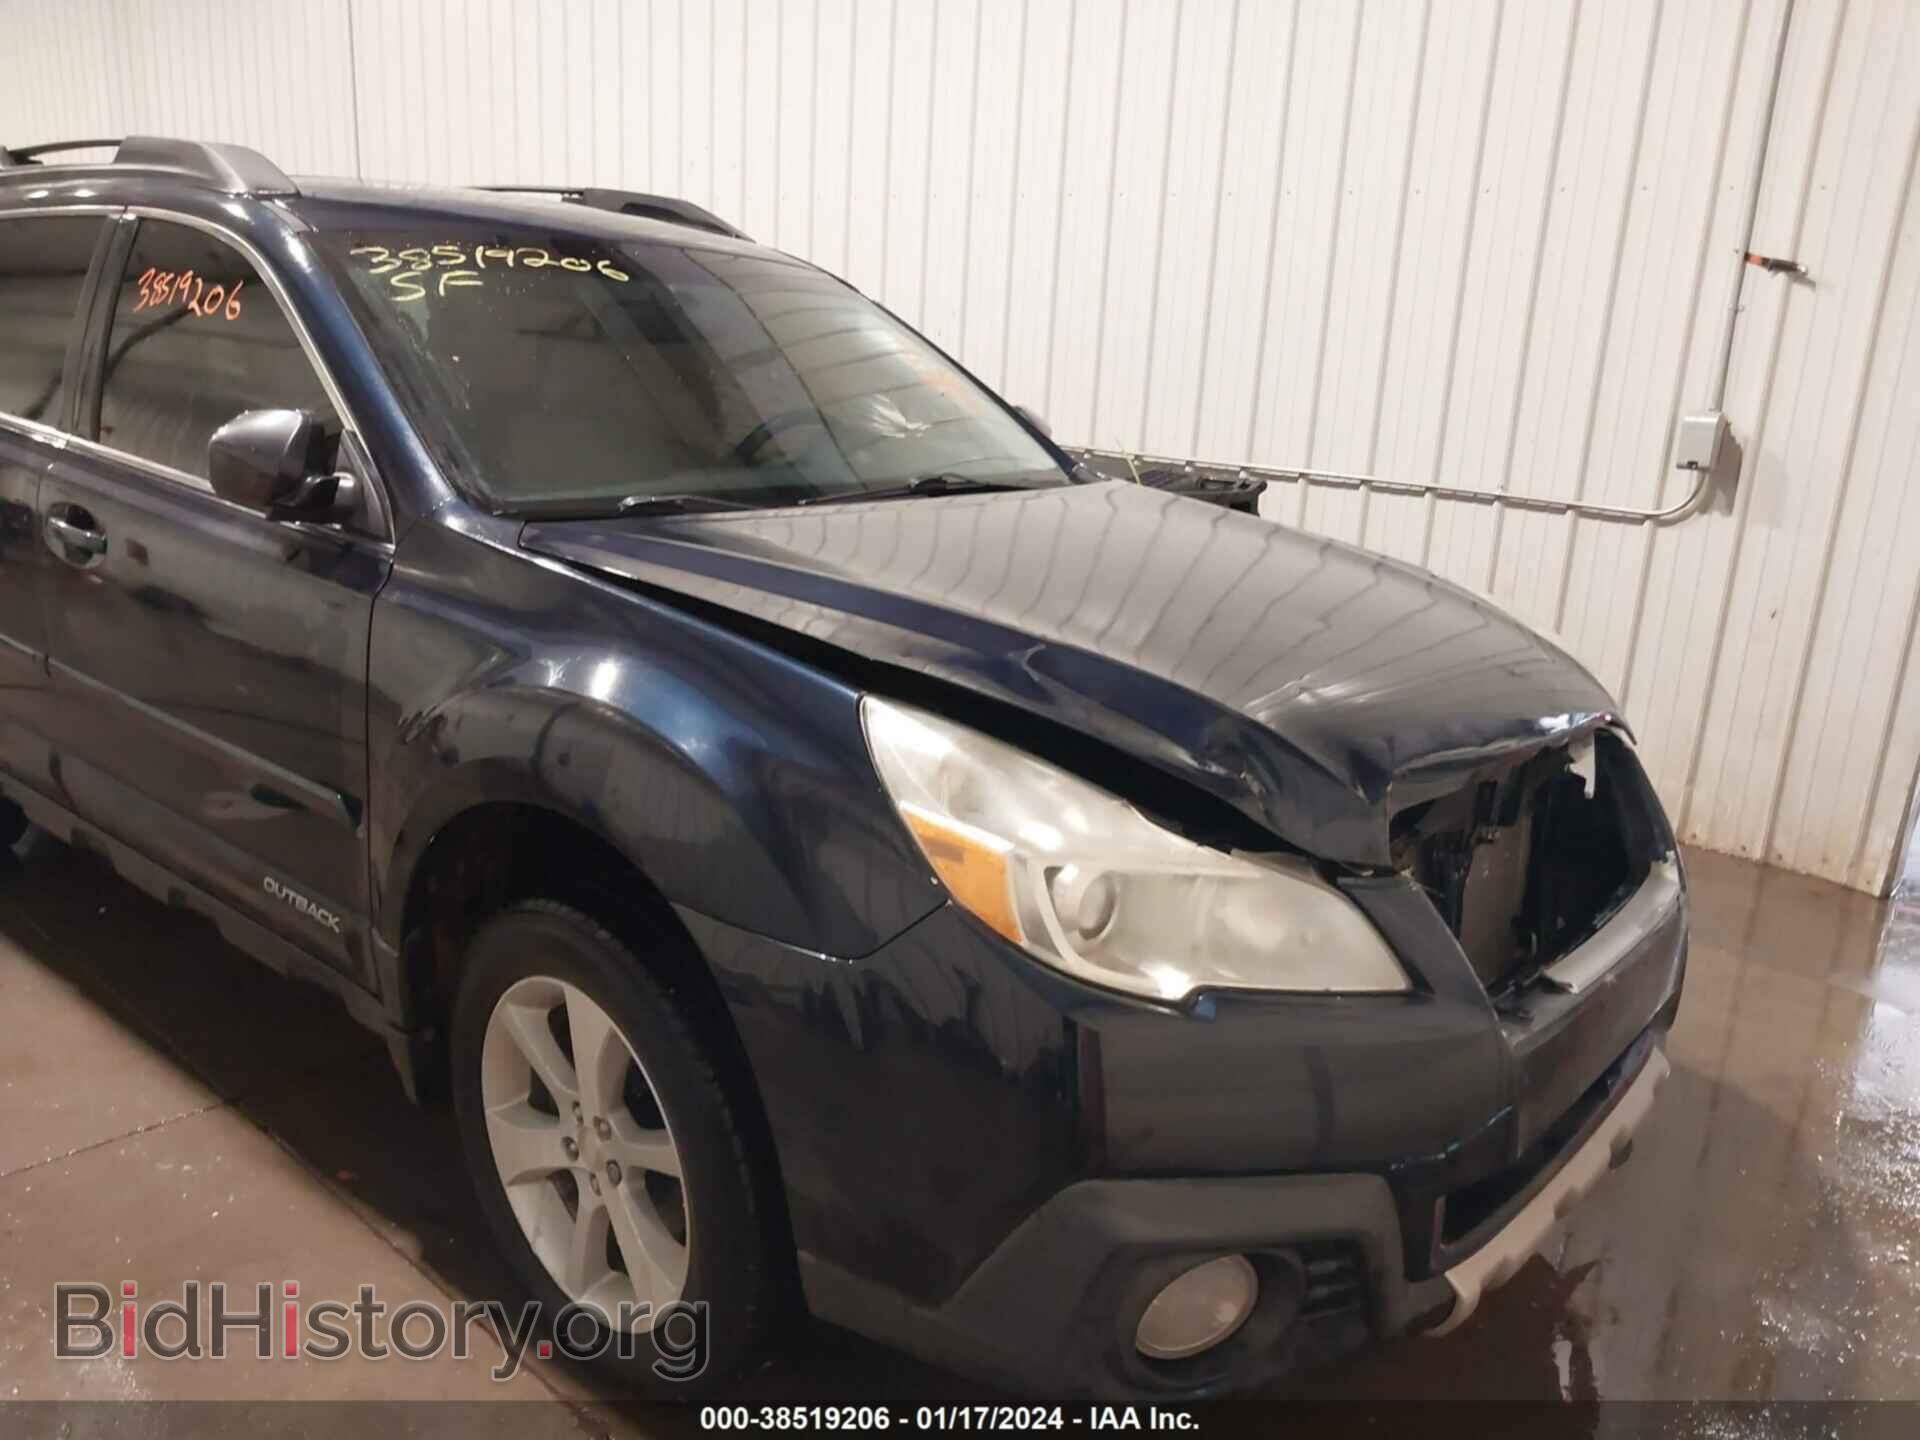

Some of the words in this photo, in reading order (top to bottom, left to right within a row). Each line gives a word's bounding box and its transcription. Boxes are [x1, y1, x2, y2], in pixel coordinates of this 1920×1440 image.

[350, 245, 629, 282] 38519206
[132, 267, 244, 320] 38519206
[263, 876, 340, 933] OUTBACK
